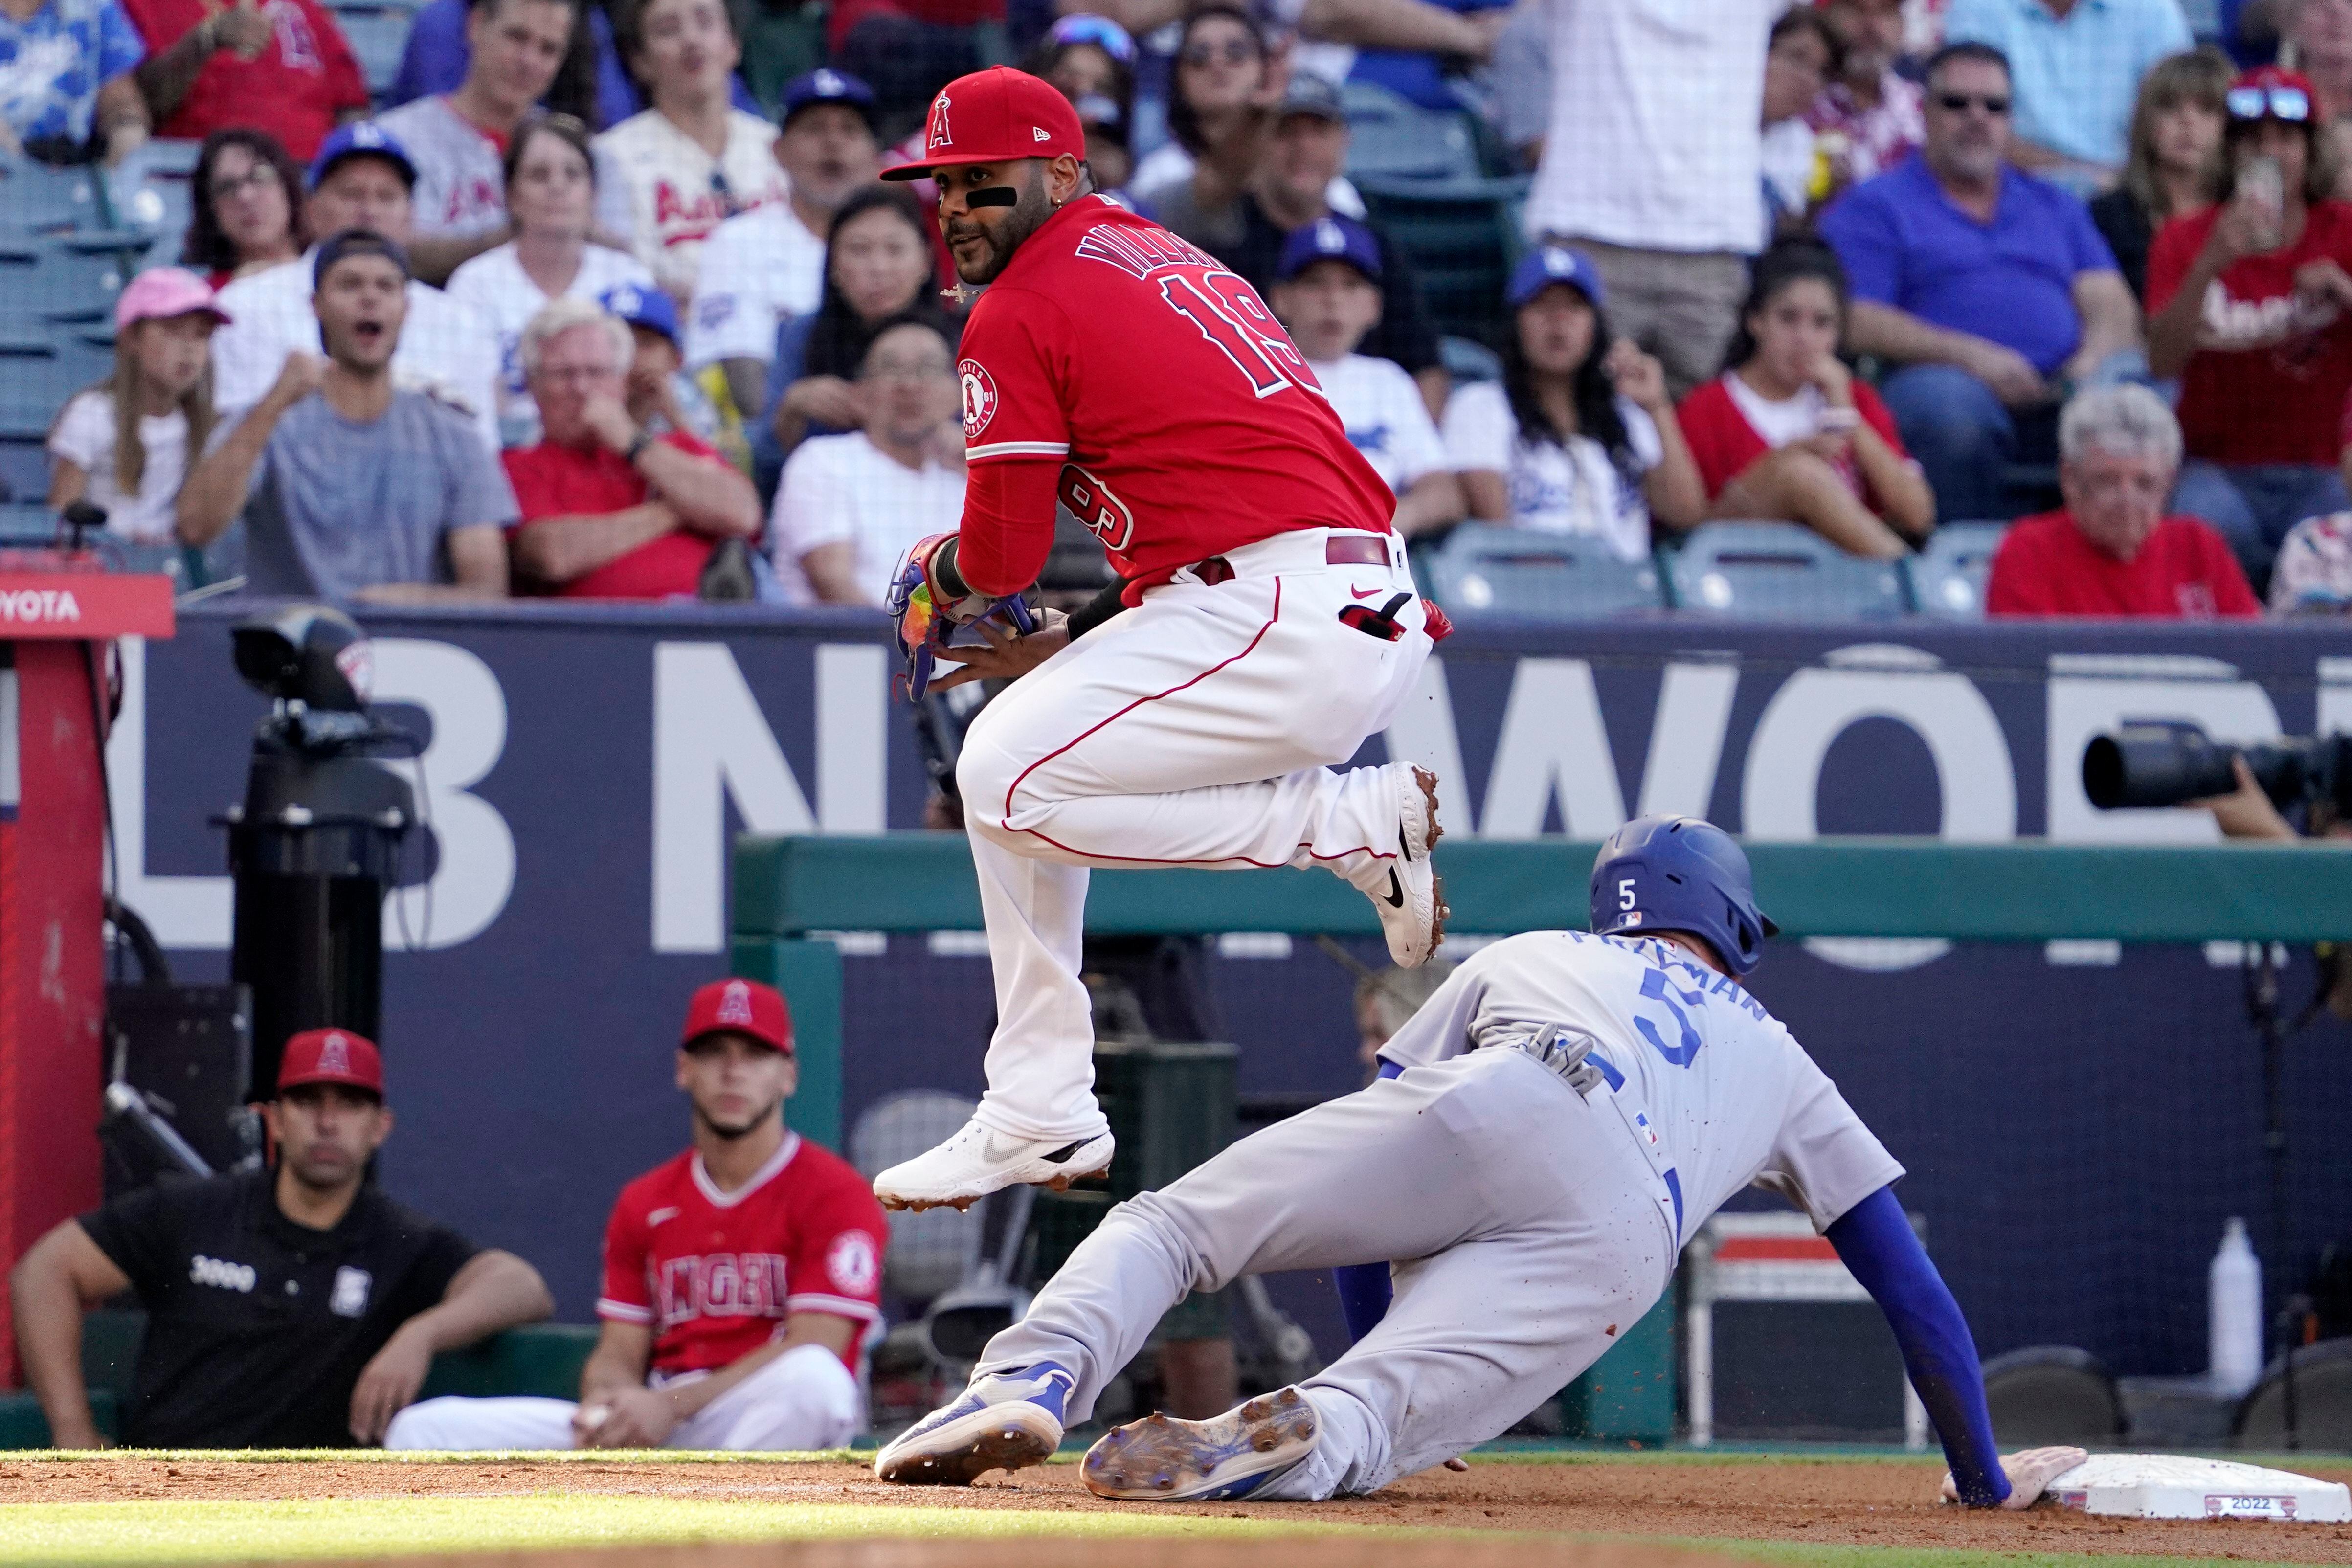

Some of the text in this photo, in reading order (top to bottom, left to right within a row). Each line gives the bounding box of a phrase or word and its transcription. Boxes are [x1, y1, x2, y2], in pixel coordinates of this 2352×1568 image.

[1157, 271, 1328, 399] 19
[1058, 463, 1134, 551] 9
[0, 589, 81, 622] YOTA
[1618, 878, 1636, 911] 5
[1634, 967, 1707, 1070] 5
[2231, 1497, 2271, 1509] 2022
